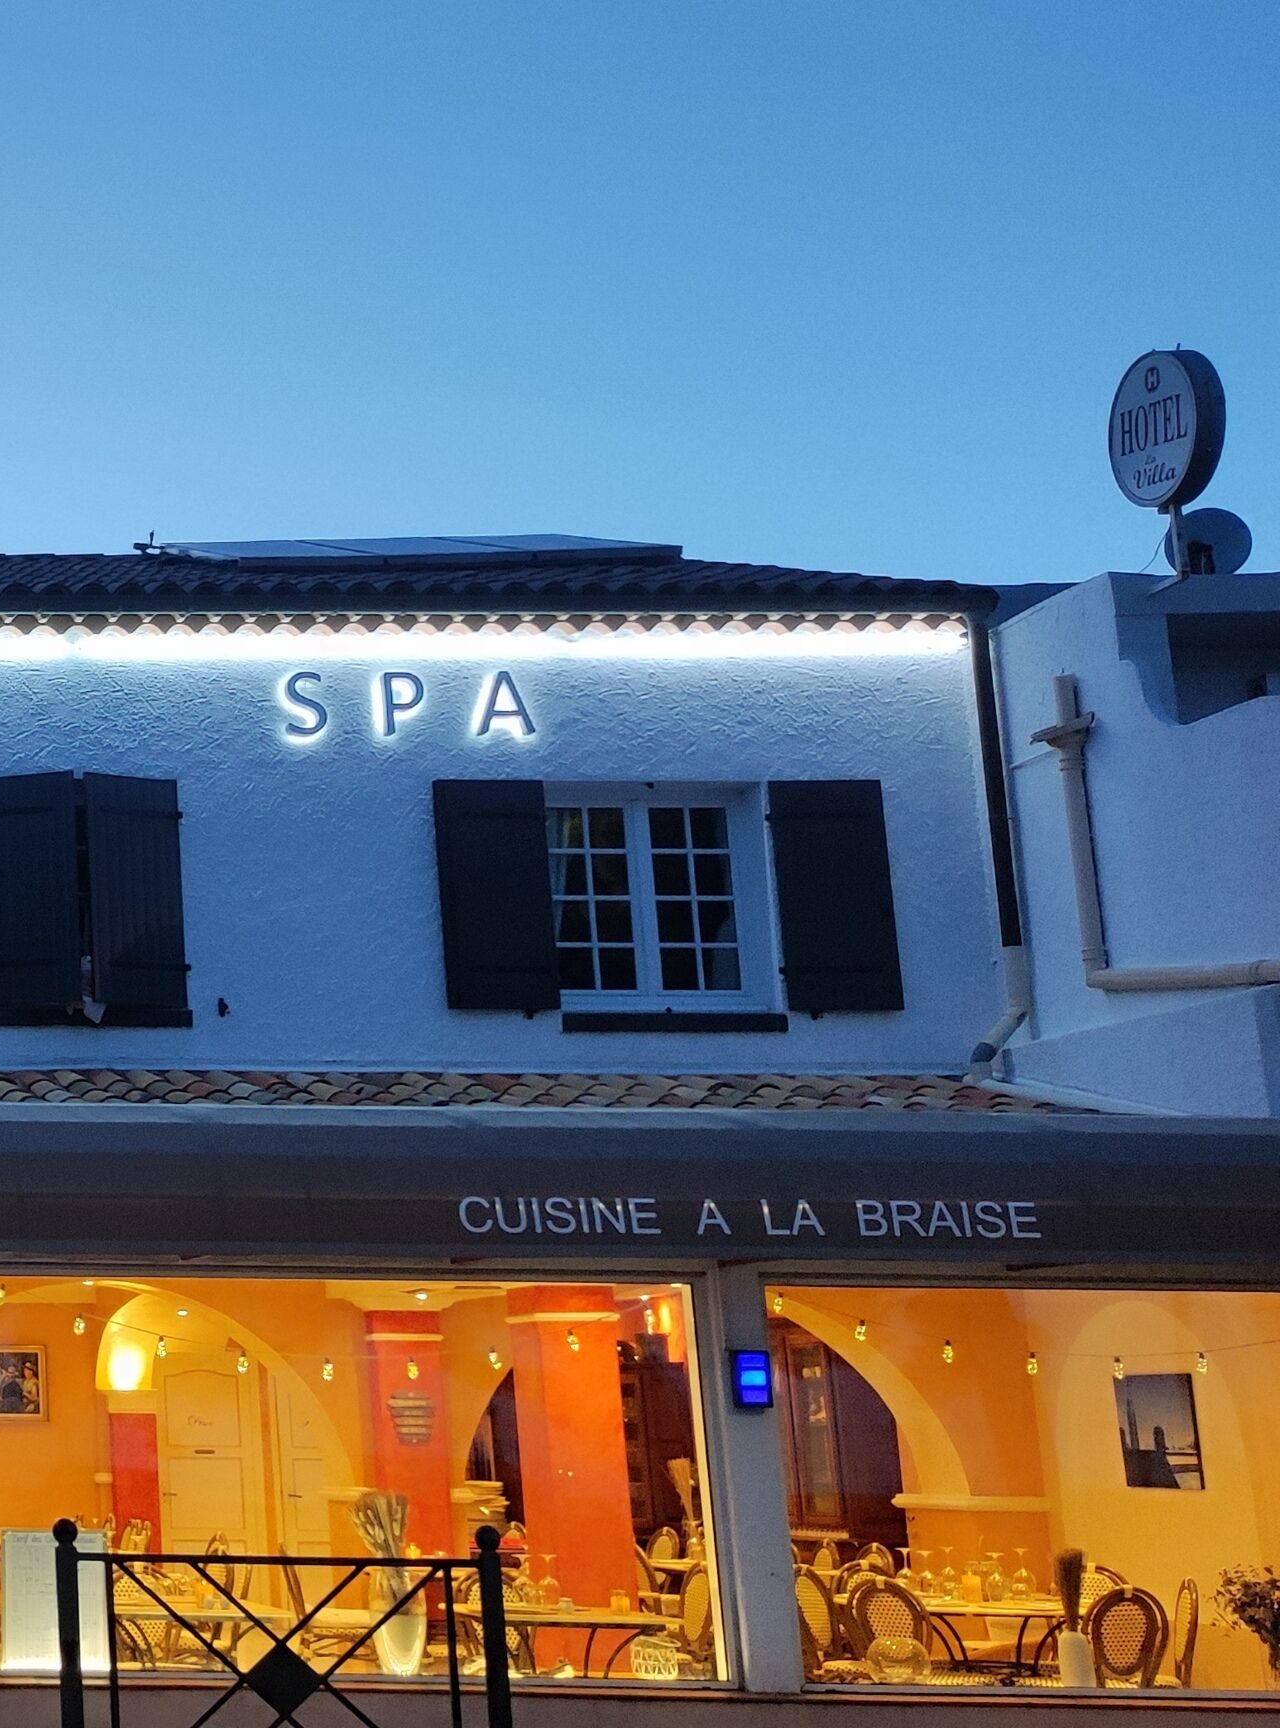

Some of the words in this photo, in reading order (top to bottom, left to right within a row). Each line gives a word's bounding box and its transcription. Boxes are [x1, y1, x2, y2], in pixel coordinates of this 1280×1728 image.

[1120, 393, 1187, 457] HOTEL
[1133, 463, 1176, 489] Villa
[284, 671, 536, 737] SPA
[458, 1196, 661, 1235] CUISINE
[697, 1199, 732, 1236] A
[761, 1199, 825, 1237] LA
[857, 1200, 1042, 1239] BRAISE
